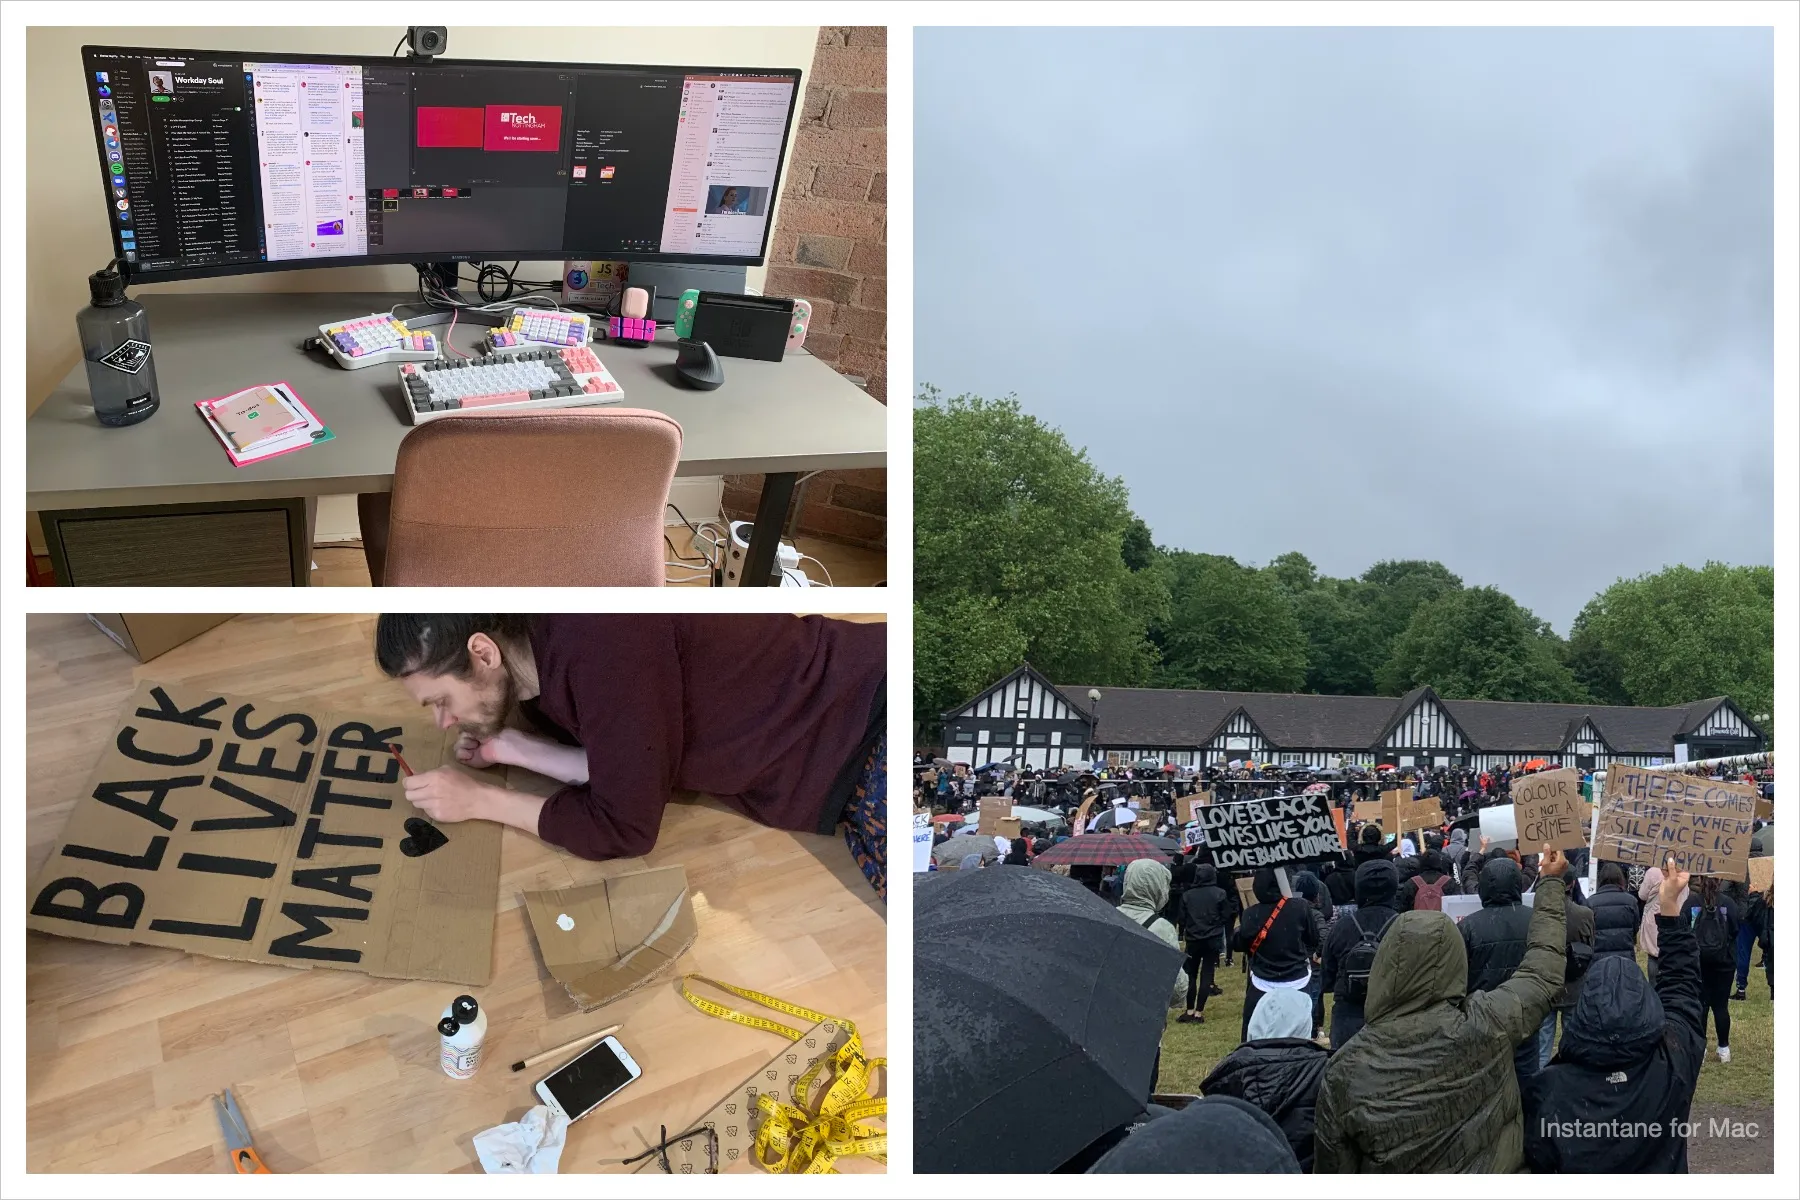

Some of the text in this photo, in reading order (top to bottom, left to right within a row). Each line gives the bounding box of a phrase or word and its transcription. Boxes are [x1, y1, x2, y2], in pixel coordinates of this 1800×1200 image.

[175, 76, 224, 85] Workday Soul
[510, 113, 536, 123] Tech
[597, 263, 612, 274] JS
[597, 282, 615, 290] Tech
[1515, 781, 1569, 806] COLOUR
[1703, 787, 1754, 813] COMES
[30, 686, 227, 930] BLACK
[1198, 803, 1249, 830] LOVE
[1247, 795, 1322, 825] BLACK
[1524, 800, 1574, 819] IS NOT A
[1612, 797, 1750, 835] A TIME WHEN
[148, 703, 318, 941] LIVES
[1203, 825, 1258, 849] LIVES
[1256, 820, 1301, 843] LIKE
[1297, 815, 1335, 836] YOU
[1524, 817, 1572, 842] CRIME
[1612, 815, 1737, 856] SILENCE IS
[268, 720, 403, 964] MATTER
[1212, 848, 1257, 869] LOVE
[1255, 841, 1295, 867] BLACK
